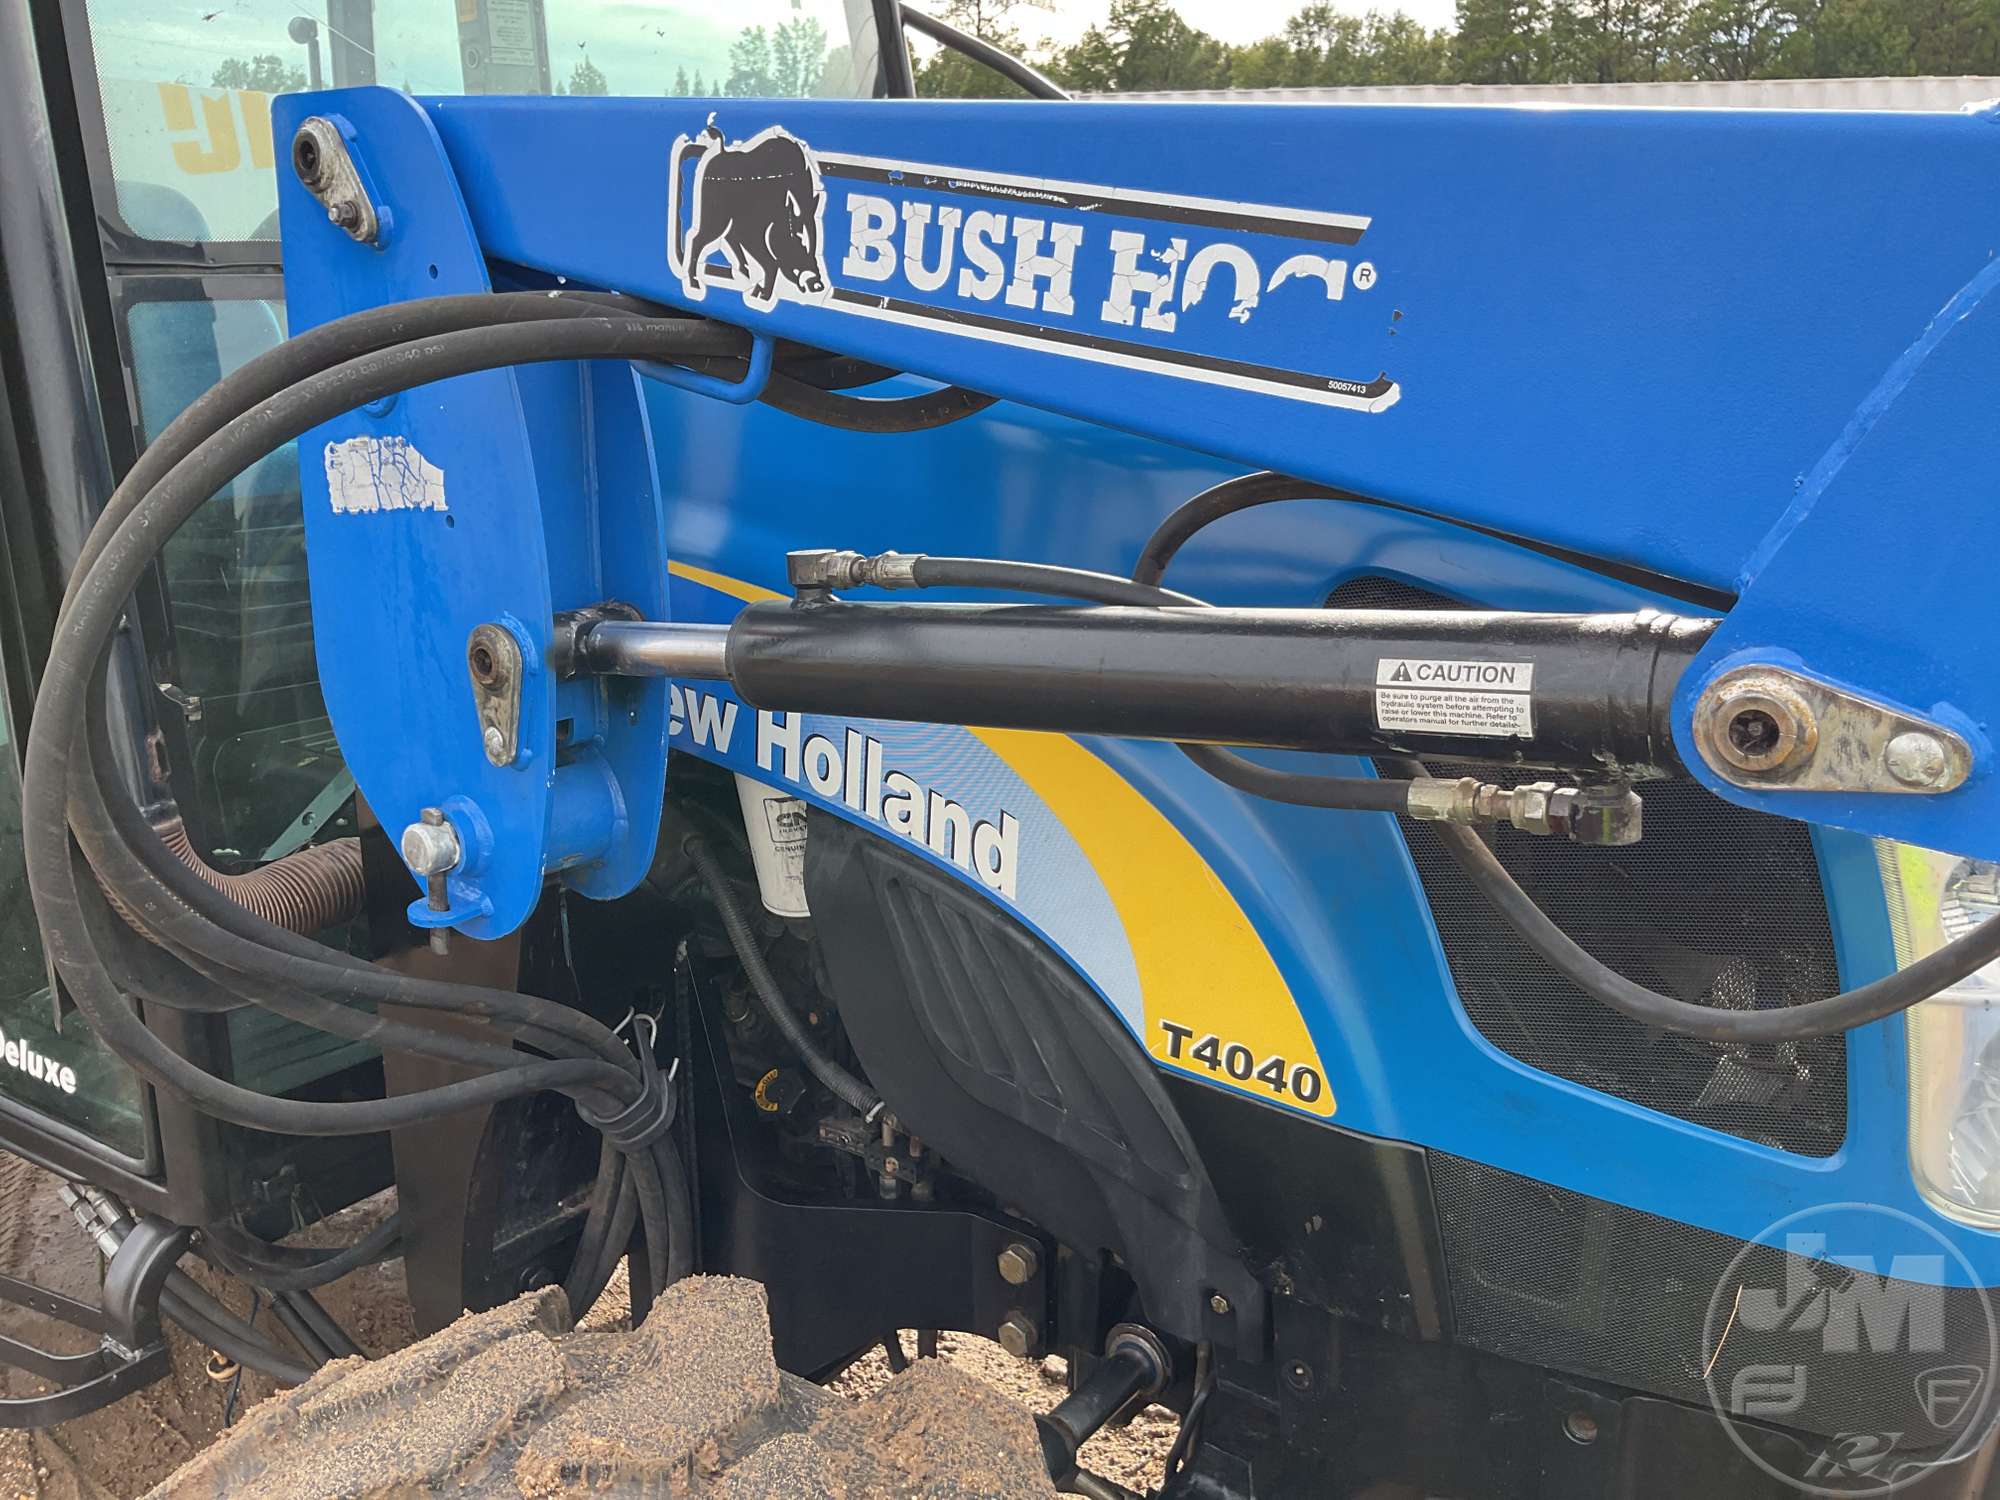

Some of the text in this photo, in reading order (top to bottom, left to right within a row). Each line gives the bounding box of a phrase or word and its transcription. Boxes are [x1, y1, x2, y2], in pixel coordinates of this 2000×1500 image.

[843, 193, 1084, 315] BUSH
[1327, 380, 1367, 395] 50057413
[1416, 663, 1516, 684] CAUTION
[1380, 691, 1391, 700] Be
[1392, 693, 1409, 701] sure
[1419, 694, 1442, 703] purge
[1454, 695, 1467, 703] the
[1468, 696, 1479, 704] air
[1480, 696, 1500, 704] from
[1501, 697, 1515, 705] the
[1381, 700, 1525, 715] hydraulic system before attempting to
[1410, 709, 1432, 718] lower
[1432, 710, 1448, 718] this
[1486, 712, 1507, 721] Refer
[1508, 713, 1518, 721] to
[1382, 715, 1418, 724] operators
[1419, 717, 1447, 725] manual
[1448, 718, 1460, 726] for
[1461, 719, 1488, 728] further
[756, 711, 1020, 902] Holland
[1160, 1018, 1322, 1104] T4040
